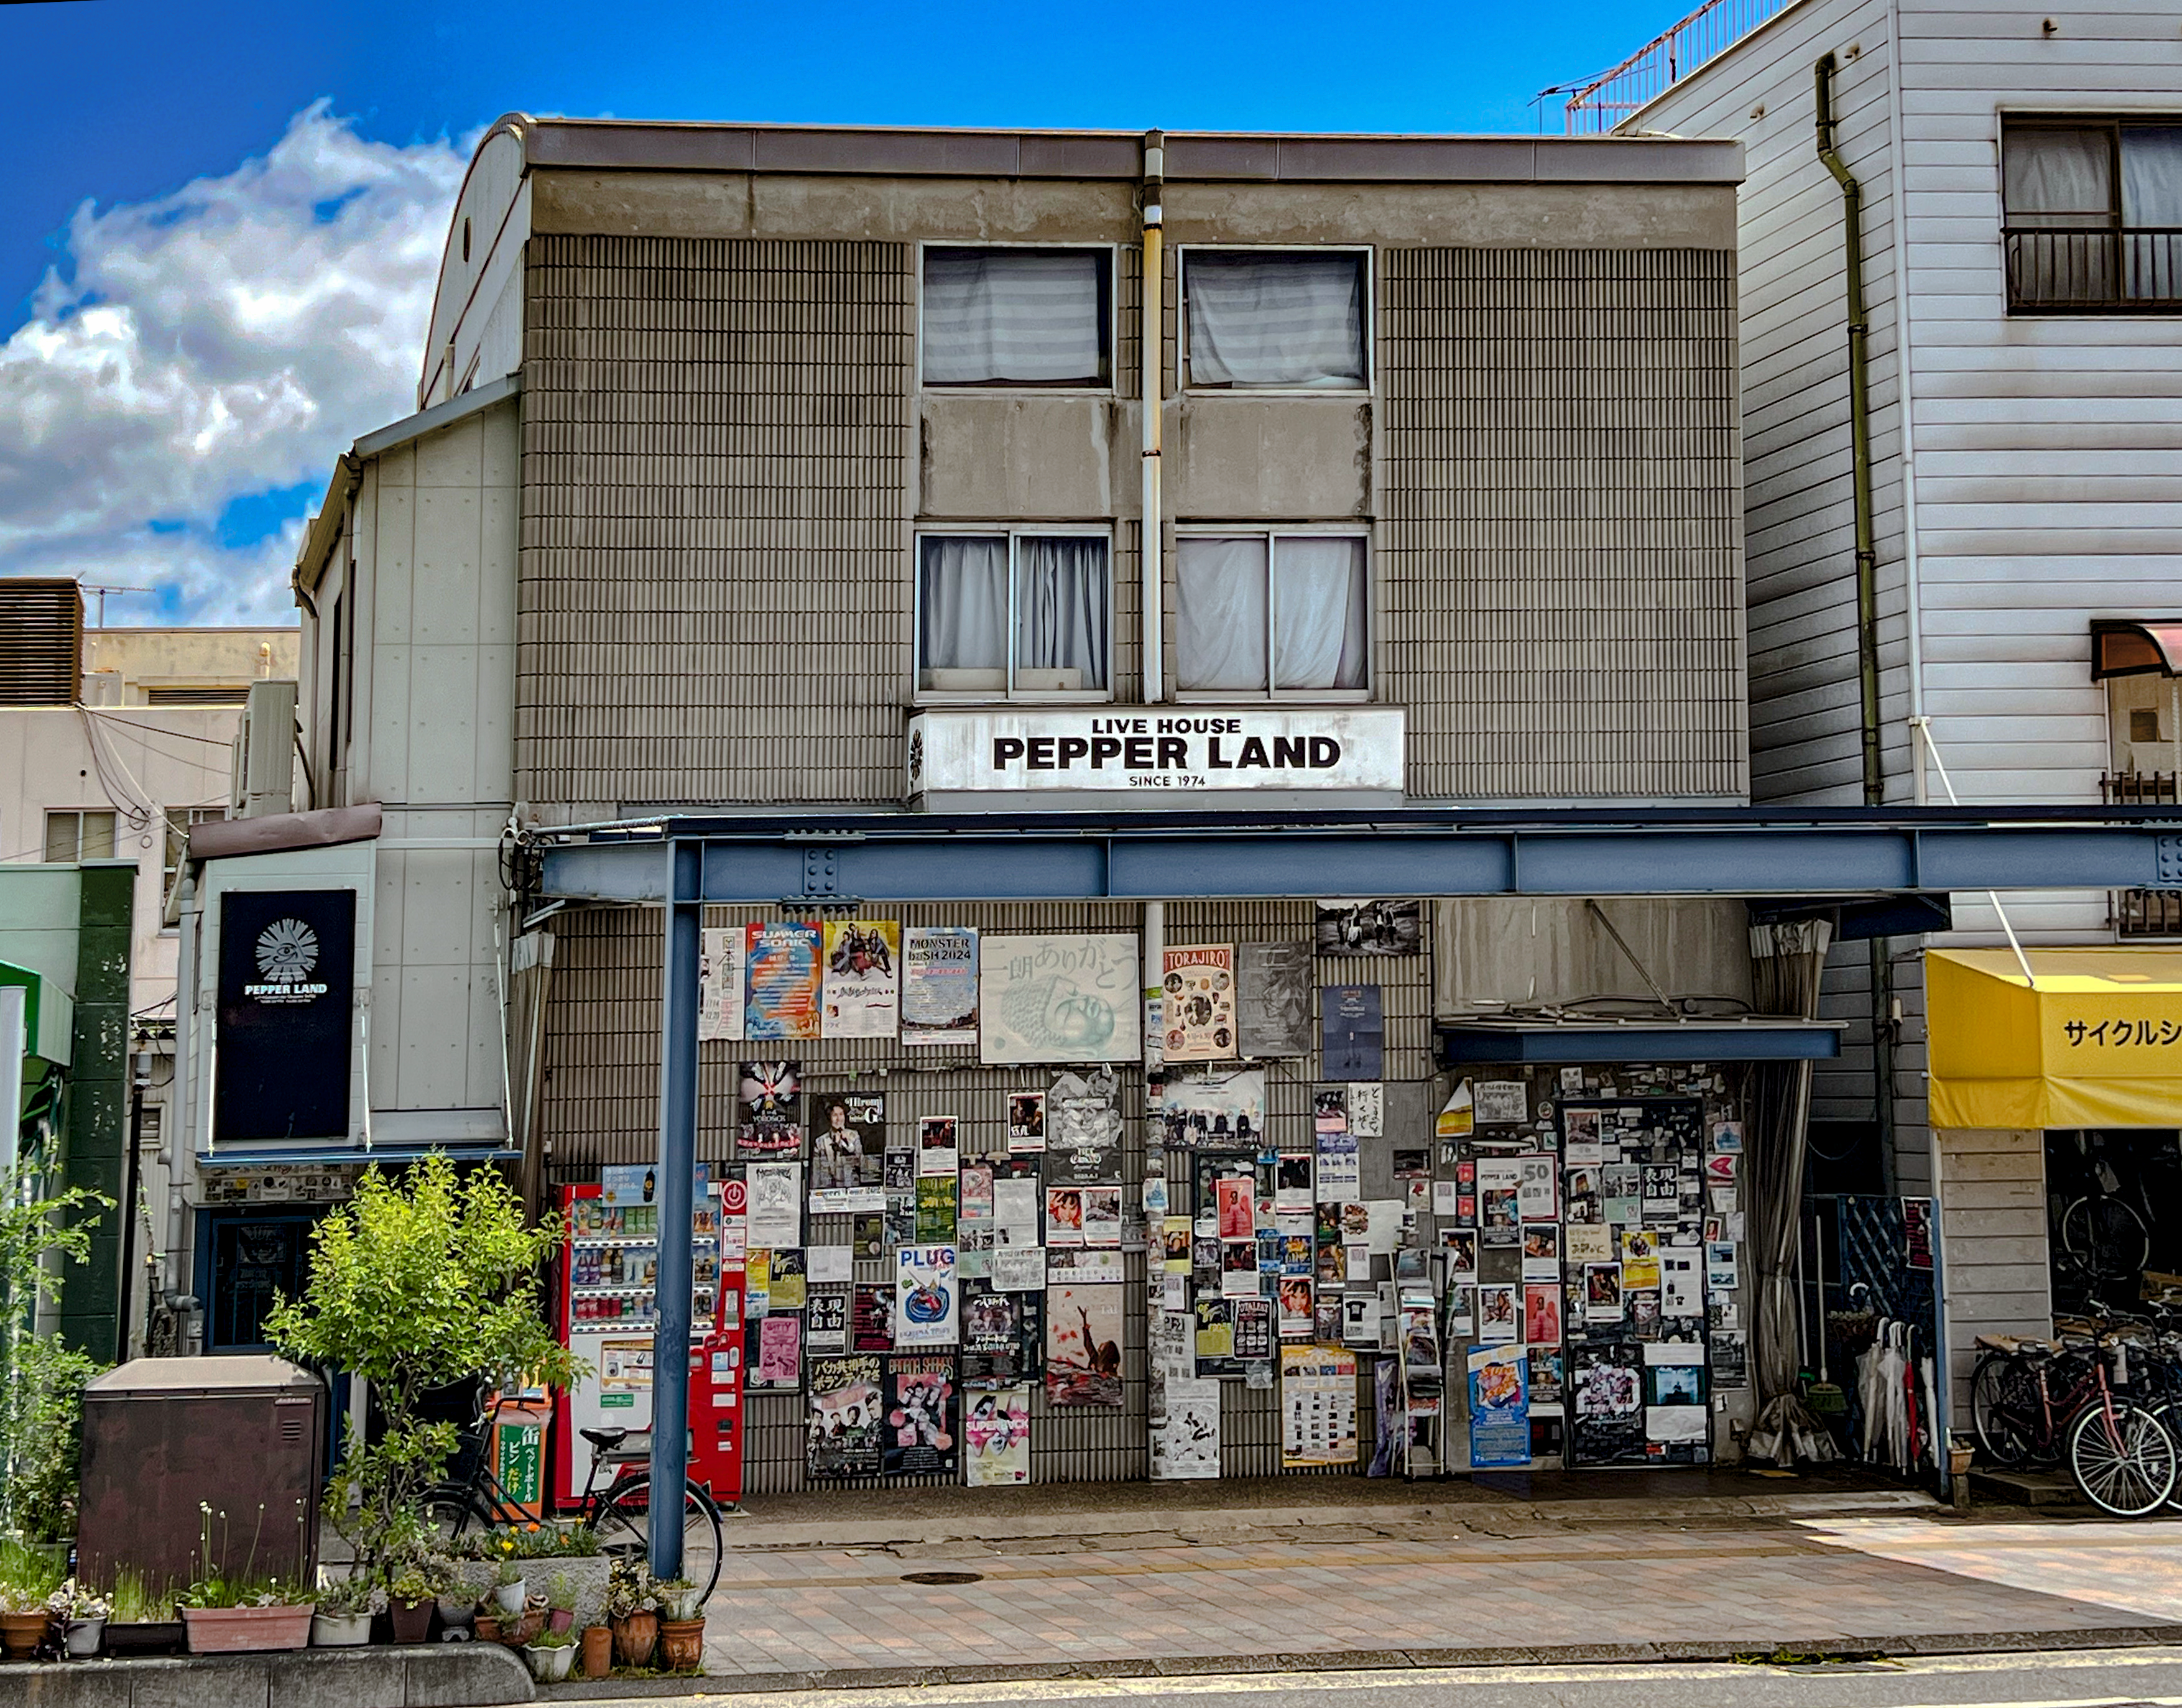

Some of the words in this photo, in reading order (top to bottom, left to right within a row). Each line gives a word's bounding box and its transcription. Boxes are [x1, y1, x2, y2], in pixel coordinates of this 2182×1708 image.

[1092, 719, 1146, 734] LIVE
[1158, 719, 1241, 734] HOUSE
[994, 737, 1187, 770] PEPPER
[1208, 737, 1341, 769] LAND
[1129, 776, 1172, 787] SINCE
[1177, 776, 1206, 787] 1974
[751, 929, 817, 940] SUMMER
[759, 939, 811, 948] SONIC
[909, 938, 969, 949] MONSTER
[941, 951, 971, 960] 2024
[1035, 937, 1137, 990] ありがとう
[1168, 949, 1226, 969] TORAJIRO
[244, 984, 291, 995] PEPPER
[294, 983, 328, 994] LAND
[2064, 1020, 2182, 1046] サイクルシ
[1524, 1165, 1550, 1181] 50
[1643, 1167, 1678, 1183] 表現
[1646, 1182, 1675, 1197] 自由
[901, 1249, 955, 1267] PLUG
[809, 1298, 845, 1314] 表現
[811, 1313, 842, 1329] 自由
[522, 1426, 540, 1446] 缶
[509, 1441, 521, 1465] ビン
[507, 1467, 522, 1495] だけ
[524, 1447, 535, 1502] ペットボトル
